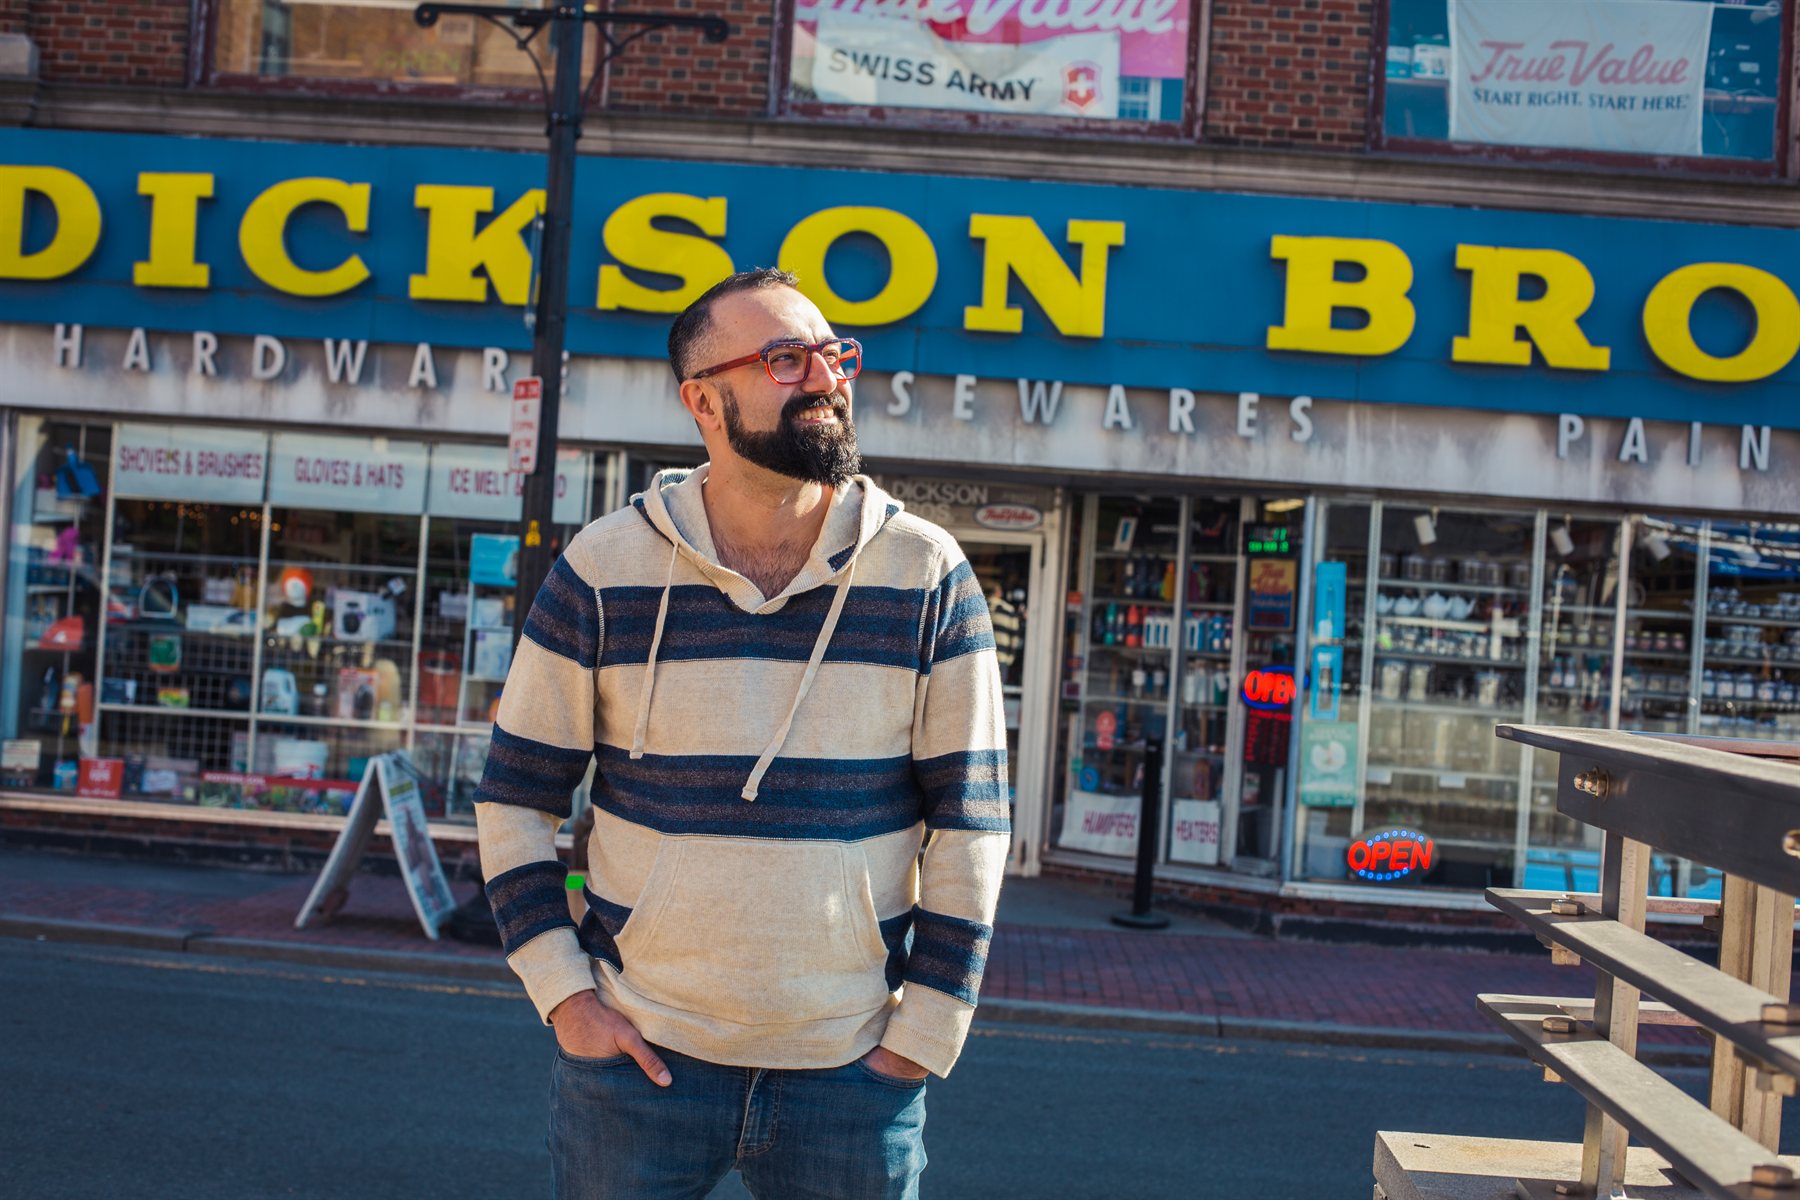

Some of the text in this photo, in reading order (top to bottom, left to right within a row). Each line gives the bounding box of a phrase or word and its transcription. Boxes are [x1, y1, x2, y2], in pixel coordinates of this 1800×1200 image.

[828, 48, 1036, 102] SWISS ARMY
[1470, 39, 1690, 87] True Value
[1473, 87, 1521, 107] START
[1528, 89, 1582, 108] RIGHT.
[1589, 92, 1637, 111] START
[0, 164, 1800, 382] DICKSON BRO
[52, 323, 1771, 472] HARDWAR SEWARES PAIN
[119, 445, 263, 480] SHOVELS & BRUSHES
[295, 456, 404, 489] GLOVES & HATS
[449, 467, 471, 495] ICE
[475, 469, 509, 497] MELT
[892, 480, 989, 506] DICKSON
[1176, 819, 1217, 845] HEATERS
[1347, 839, 1435, 871] OPEN
